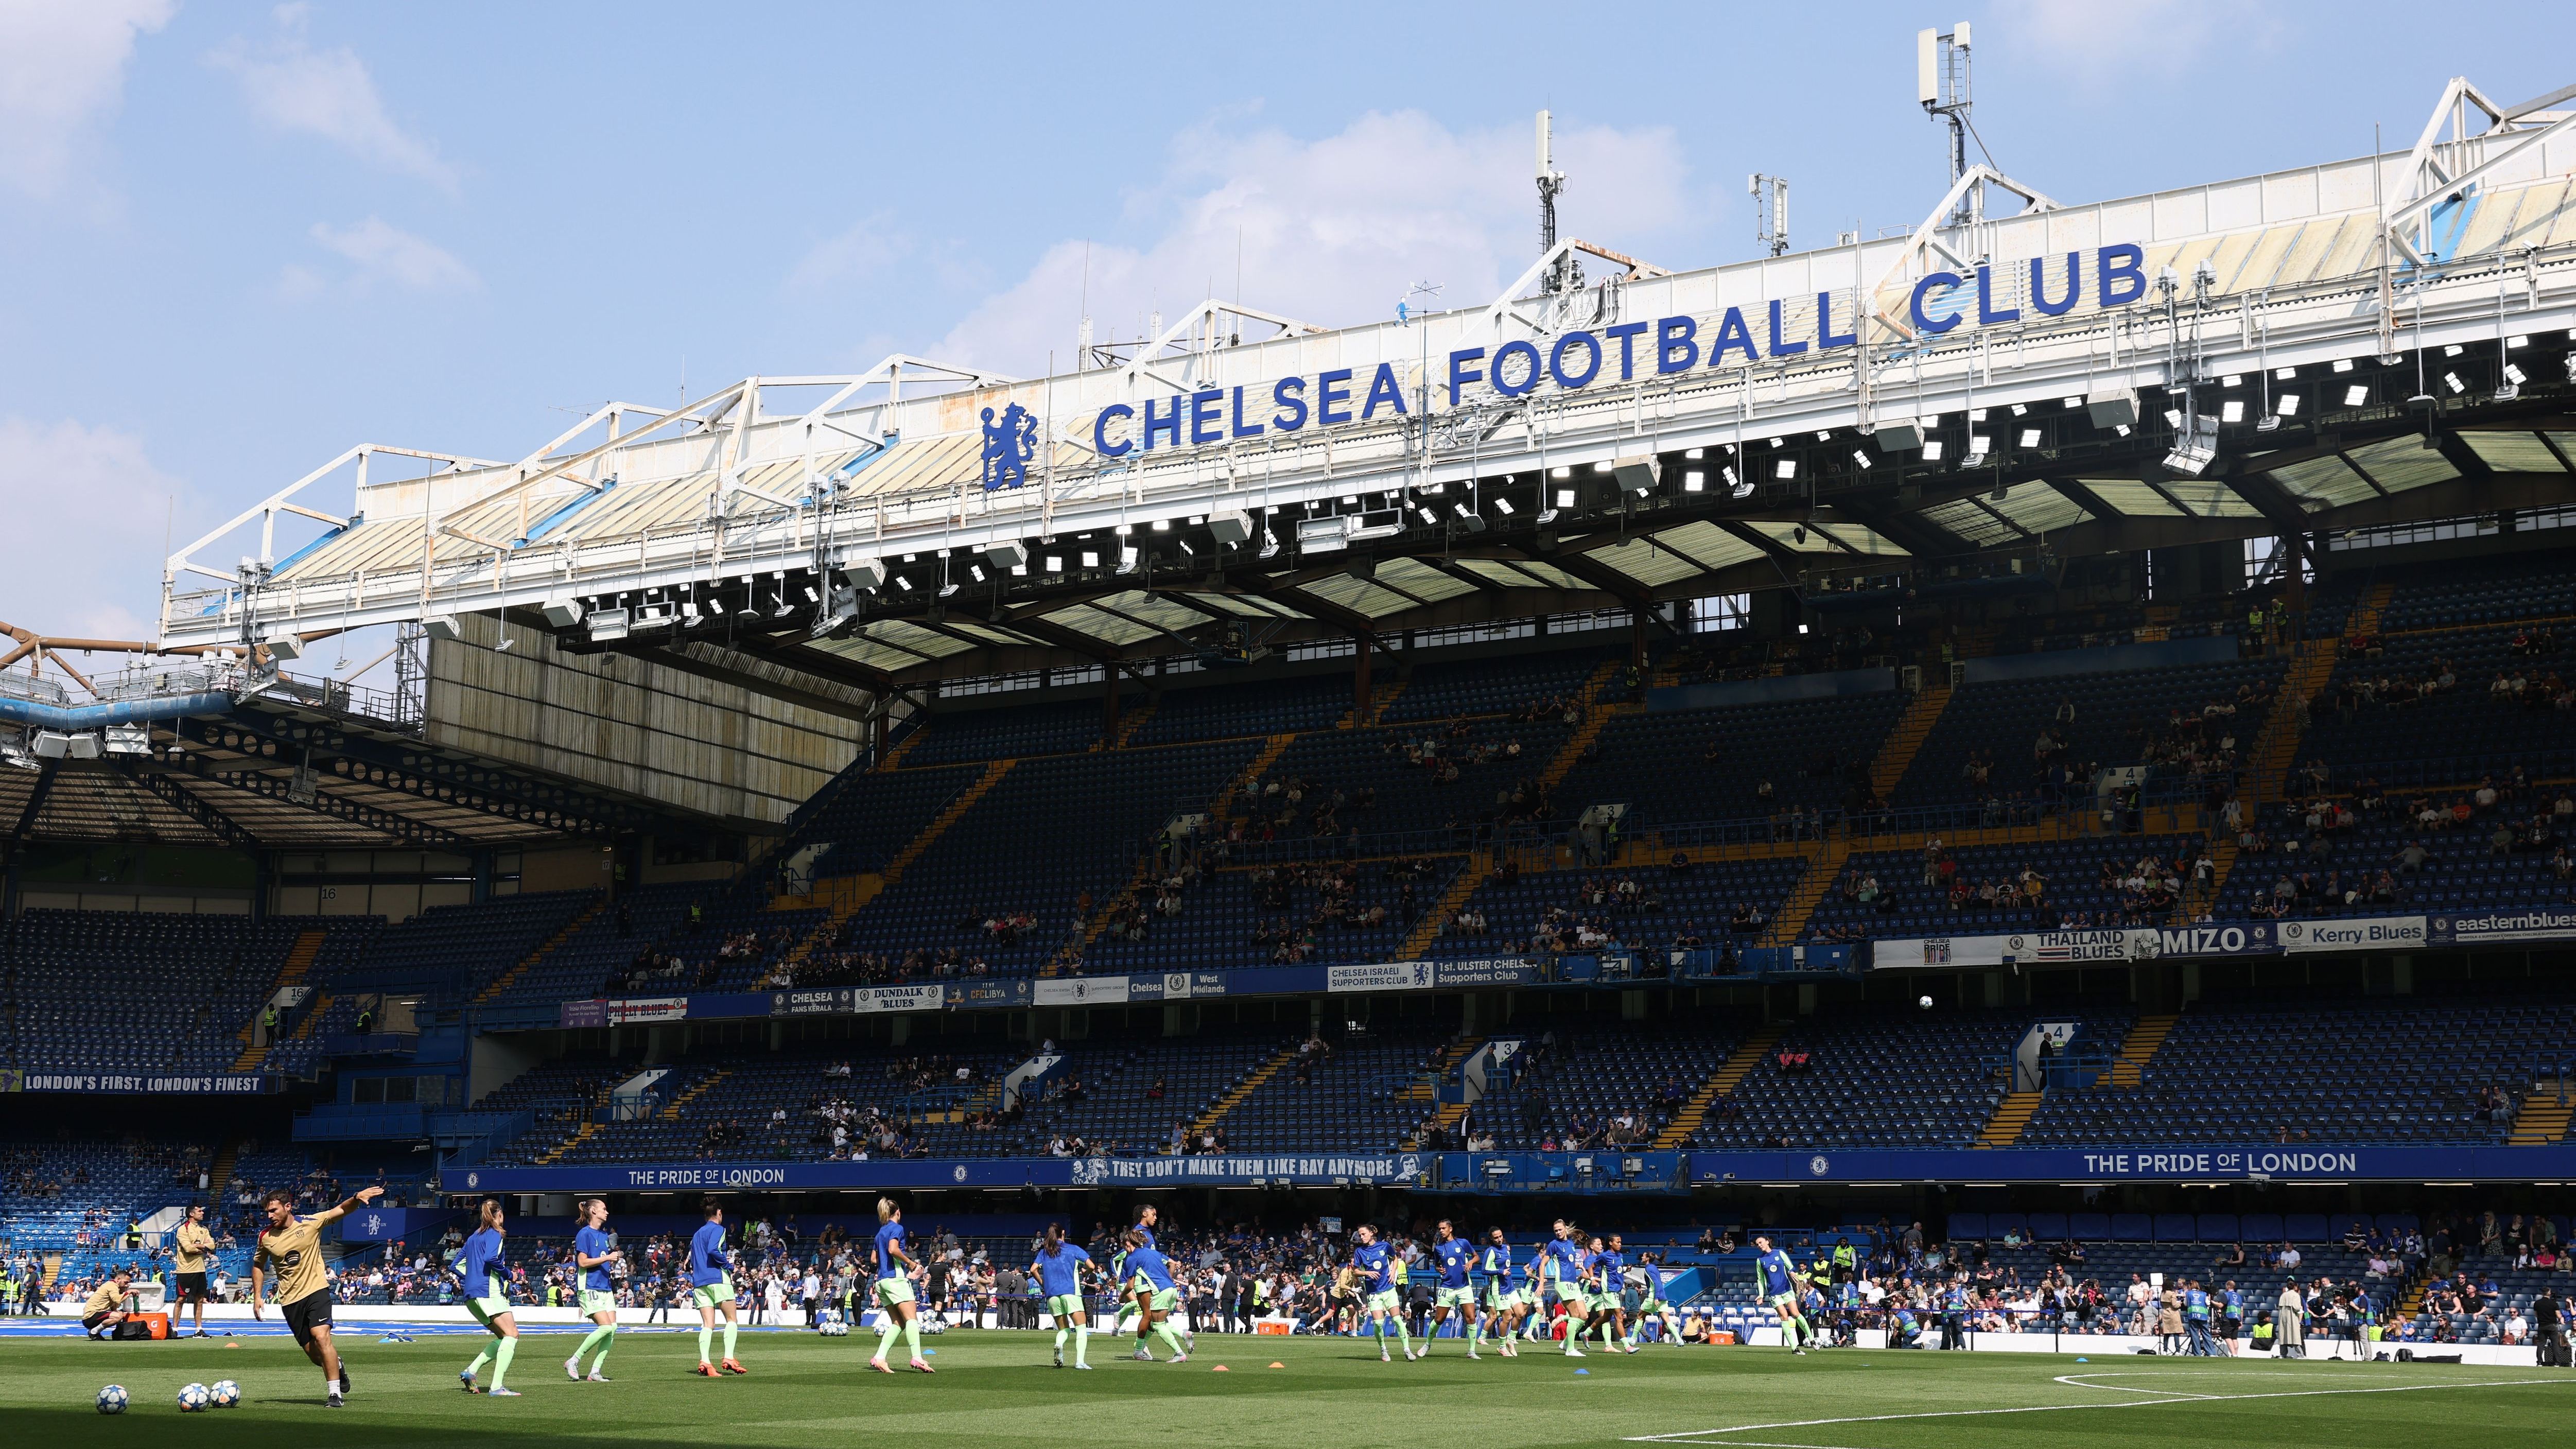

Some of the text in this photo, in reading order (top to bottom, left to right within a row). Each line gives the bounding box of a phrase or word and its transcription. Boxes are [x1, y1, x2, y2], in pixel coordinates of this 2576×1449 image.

[1094, 243, 2147, 457] CHELSEA FOOTBALL CLUB
[2126, 768, 2134, 779] 4
[1608, 806, 1614, 816] 3
[1190, 815, 1195, 825] 2
[817, 845, 822, 854] 1
[322, 888, 336, 899] 16
[2037, 931, 2125, 947] THAILAND
[2313, 925, 2422, 944] Kerry Blues
[2163, 927, 2246, 954] MIZO
[2072, 945, 2125, 959] BLUES
[1332, 967, 1399, 977] CHELSEA ISRAELI
[1439, 962, 1456, 972] 1st.
[1457, 961, 1491, 971] ULSTER
[1199, 974, 1218, 984] West
[1332, 976, 1408, 987] SUPPORTERS CLUB
[1438, 971, 1518, 984] Supporters Club
[291, 988, 303, 997] 16
[875, 987, 924, 998] DUNDALK
[1131, 983, 1162, 993] Chelsea
[1192, 984, 1225, 994] Midlands
[791, 992, 833, 1003] CHELSEA
[882, 999, 914, 1008] BLUES
[609, 1005, 638, 1018] PHILLY
[641, 1004, 669, 1017] BLUES
[2054, 1026, 2063, 1038] 4
[1504, 1043, 1511, 1055] 3
[1047, 1058, 1052, 1068] 2
[26, 1075, 259, 1092] LONDON'S FIRST, LONDON'S FINEST
[1112, 1158, 1393, 1178] THEY DON'T MAKE THEM LIKE RAY ANYMORE
[2084, 1153, 2356, 1173] THE PRIDE OF LONDON
[629, 1168, 785, 1185] THE PRIDE OF LONDON
[587, 1290, 599, 1301] 10
[1438, 1288, 1447, 1298] 24
